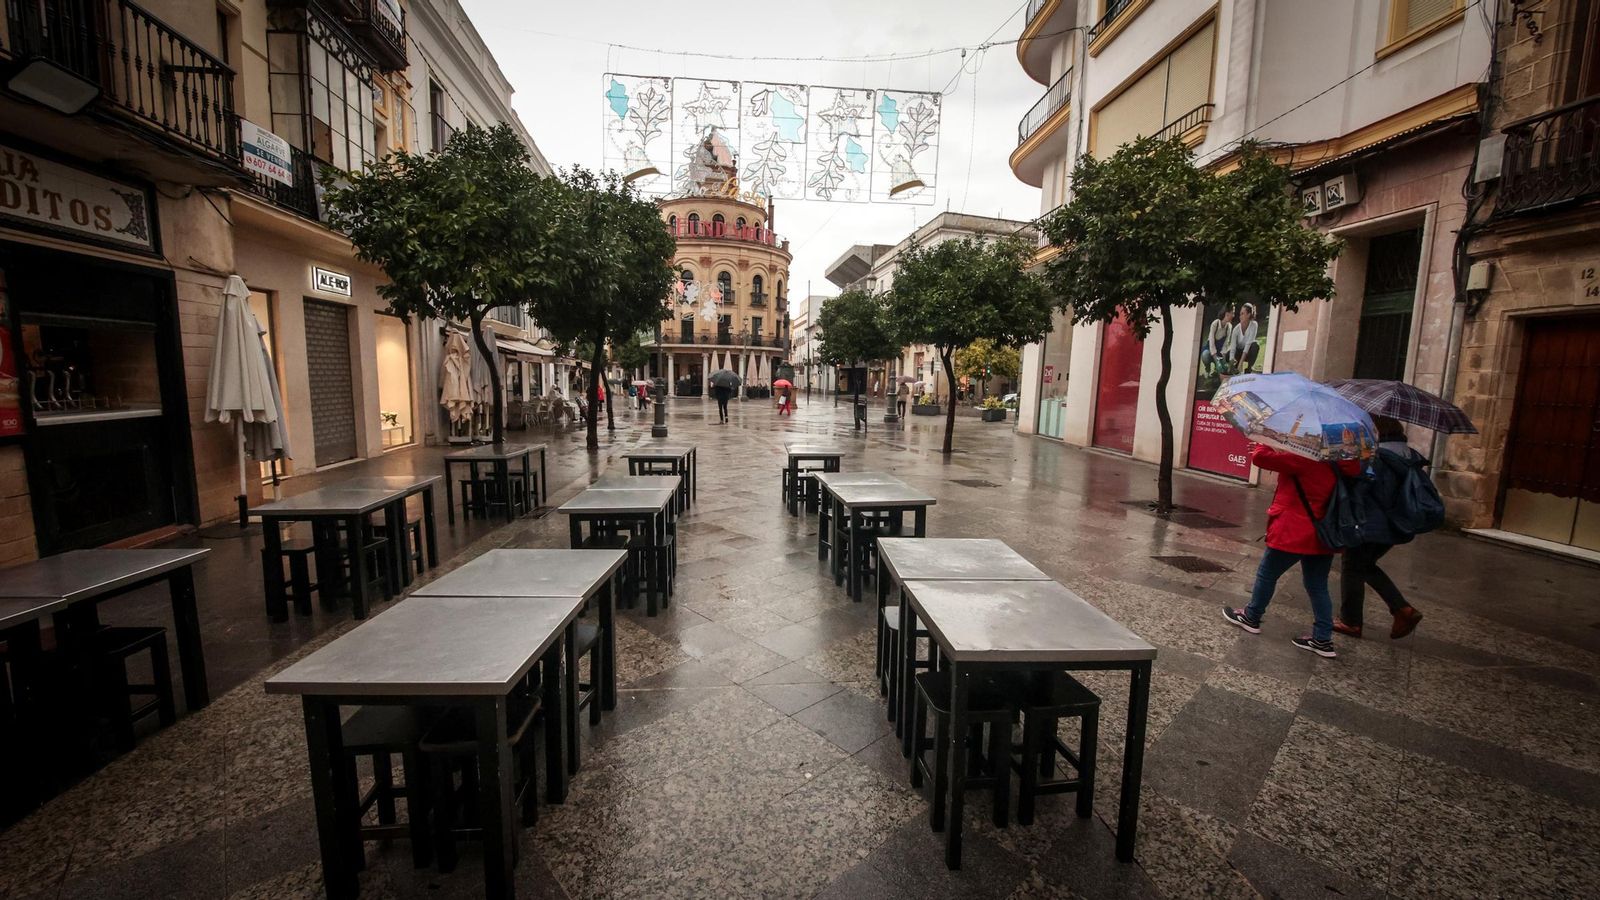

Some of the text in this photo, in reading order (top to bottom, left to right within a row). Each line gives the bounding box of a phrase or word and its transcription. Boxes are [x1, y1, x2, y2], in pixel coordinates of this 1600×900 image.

[256, 137, 286, 158] ALGARVE
[256, 149, 264, 157] SE
[253, 157, 266, 170] 607
[1581, 268, 1595, 280] 12
[1586, 286, 1600, 297] 14
[1228, 453, 1246, 464] GAES
